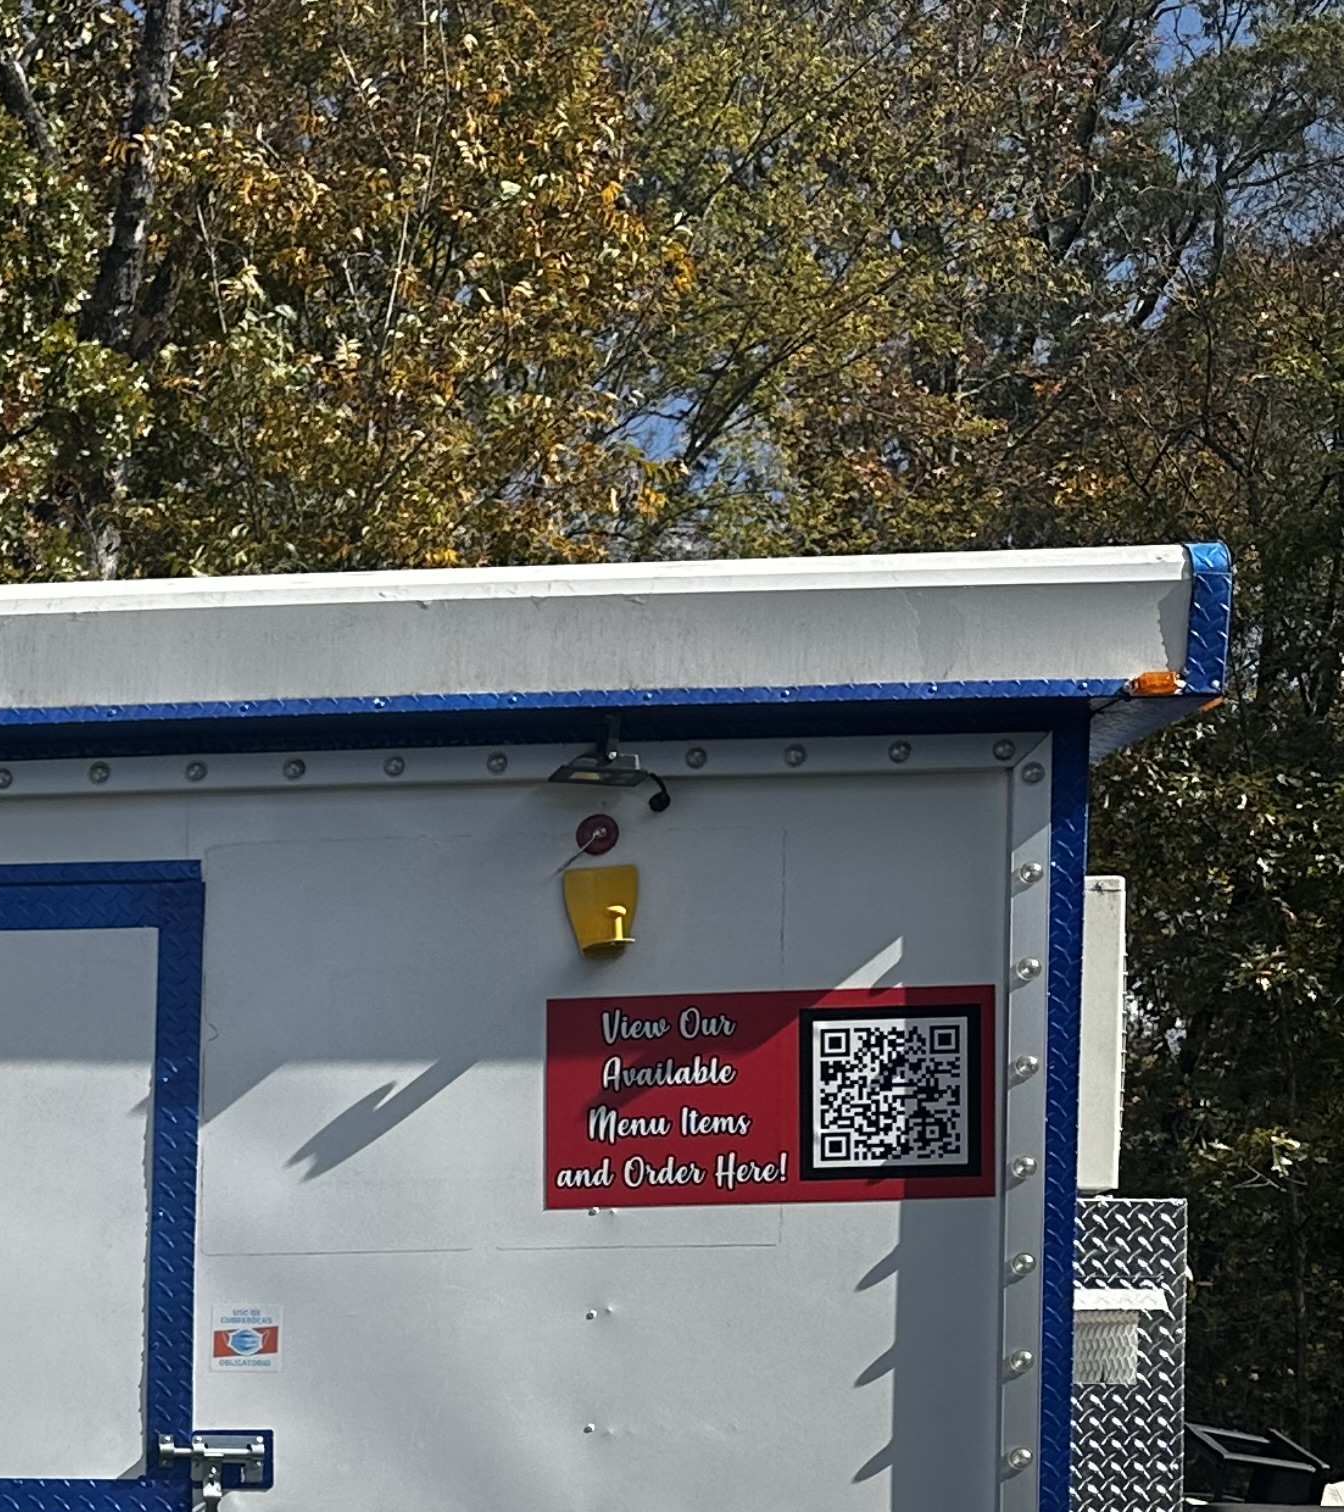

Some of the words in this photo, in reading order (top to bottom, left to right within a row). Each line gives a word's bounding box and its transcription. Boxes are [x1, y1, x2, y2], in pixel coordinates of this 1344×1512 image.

[602, 1009, 671, 1044] View
[679, 1007, 736, 1039] Our
[602, 1056, 737, 1091] Available
[588, 1106, 671, 1144] Menu
[681, 1106, 751, 1137] Items
[556, 1157, 615, 1188] and
[623, 1155, 706, 1188] Order
[714, 1151, 789, 1190] Here!
